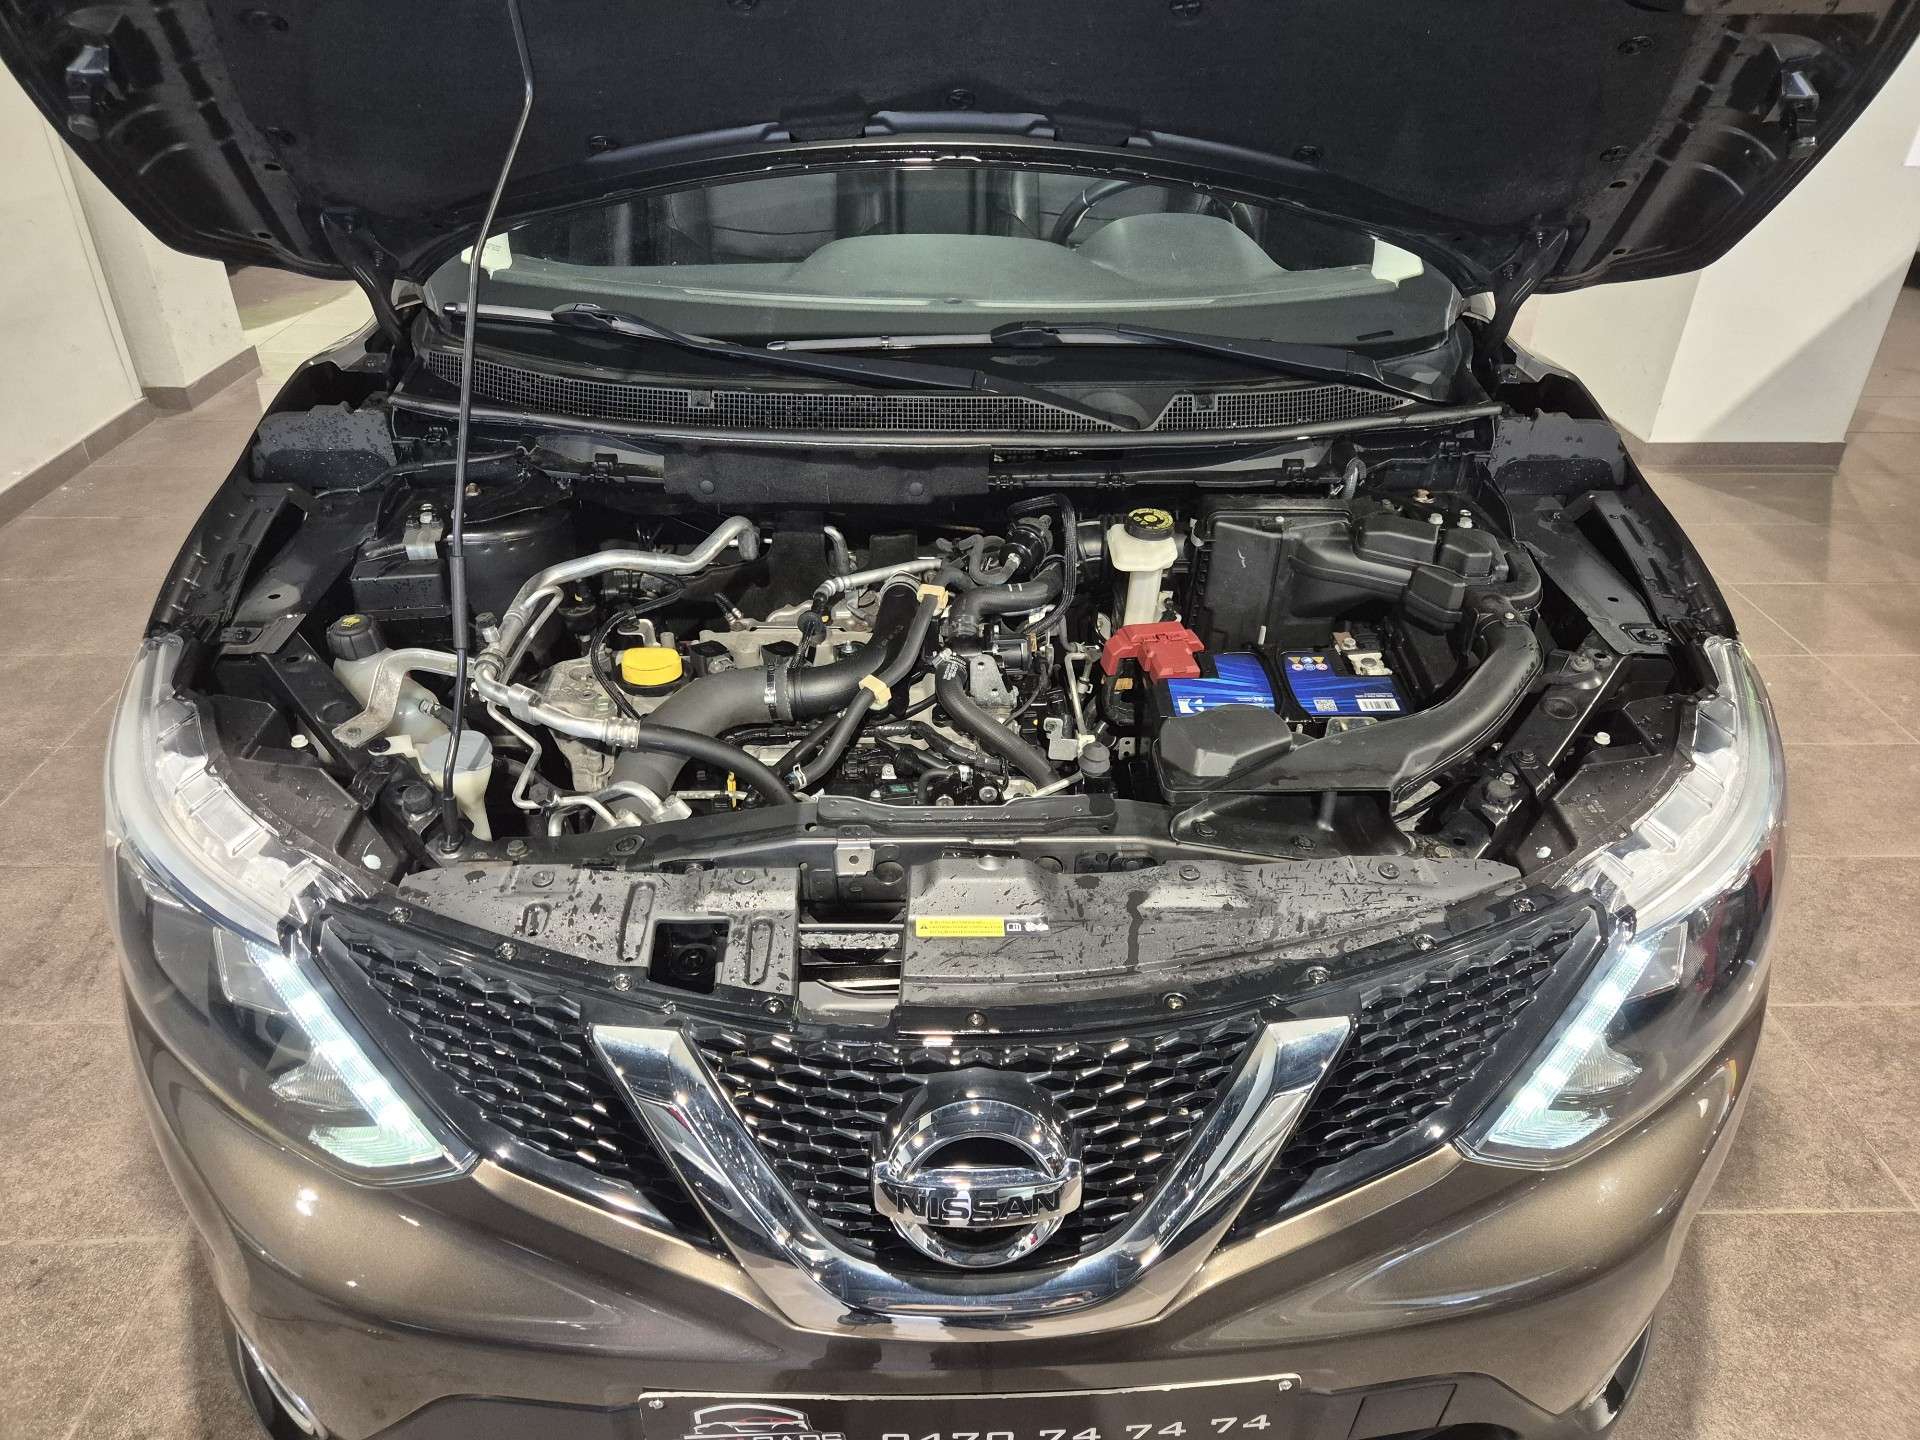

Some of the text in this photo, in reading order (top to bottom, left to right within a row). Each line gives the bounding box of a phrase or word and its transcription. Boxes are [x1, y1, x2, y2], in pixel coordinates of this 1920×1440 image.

[896, 1191, 1062, 1222] NISSAN
[1125, 1421, 1187, 1440] 74
[1210, 1414, 1271, 1434] 74
